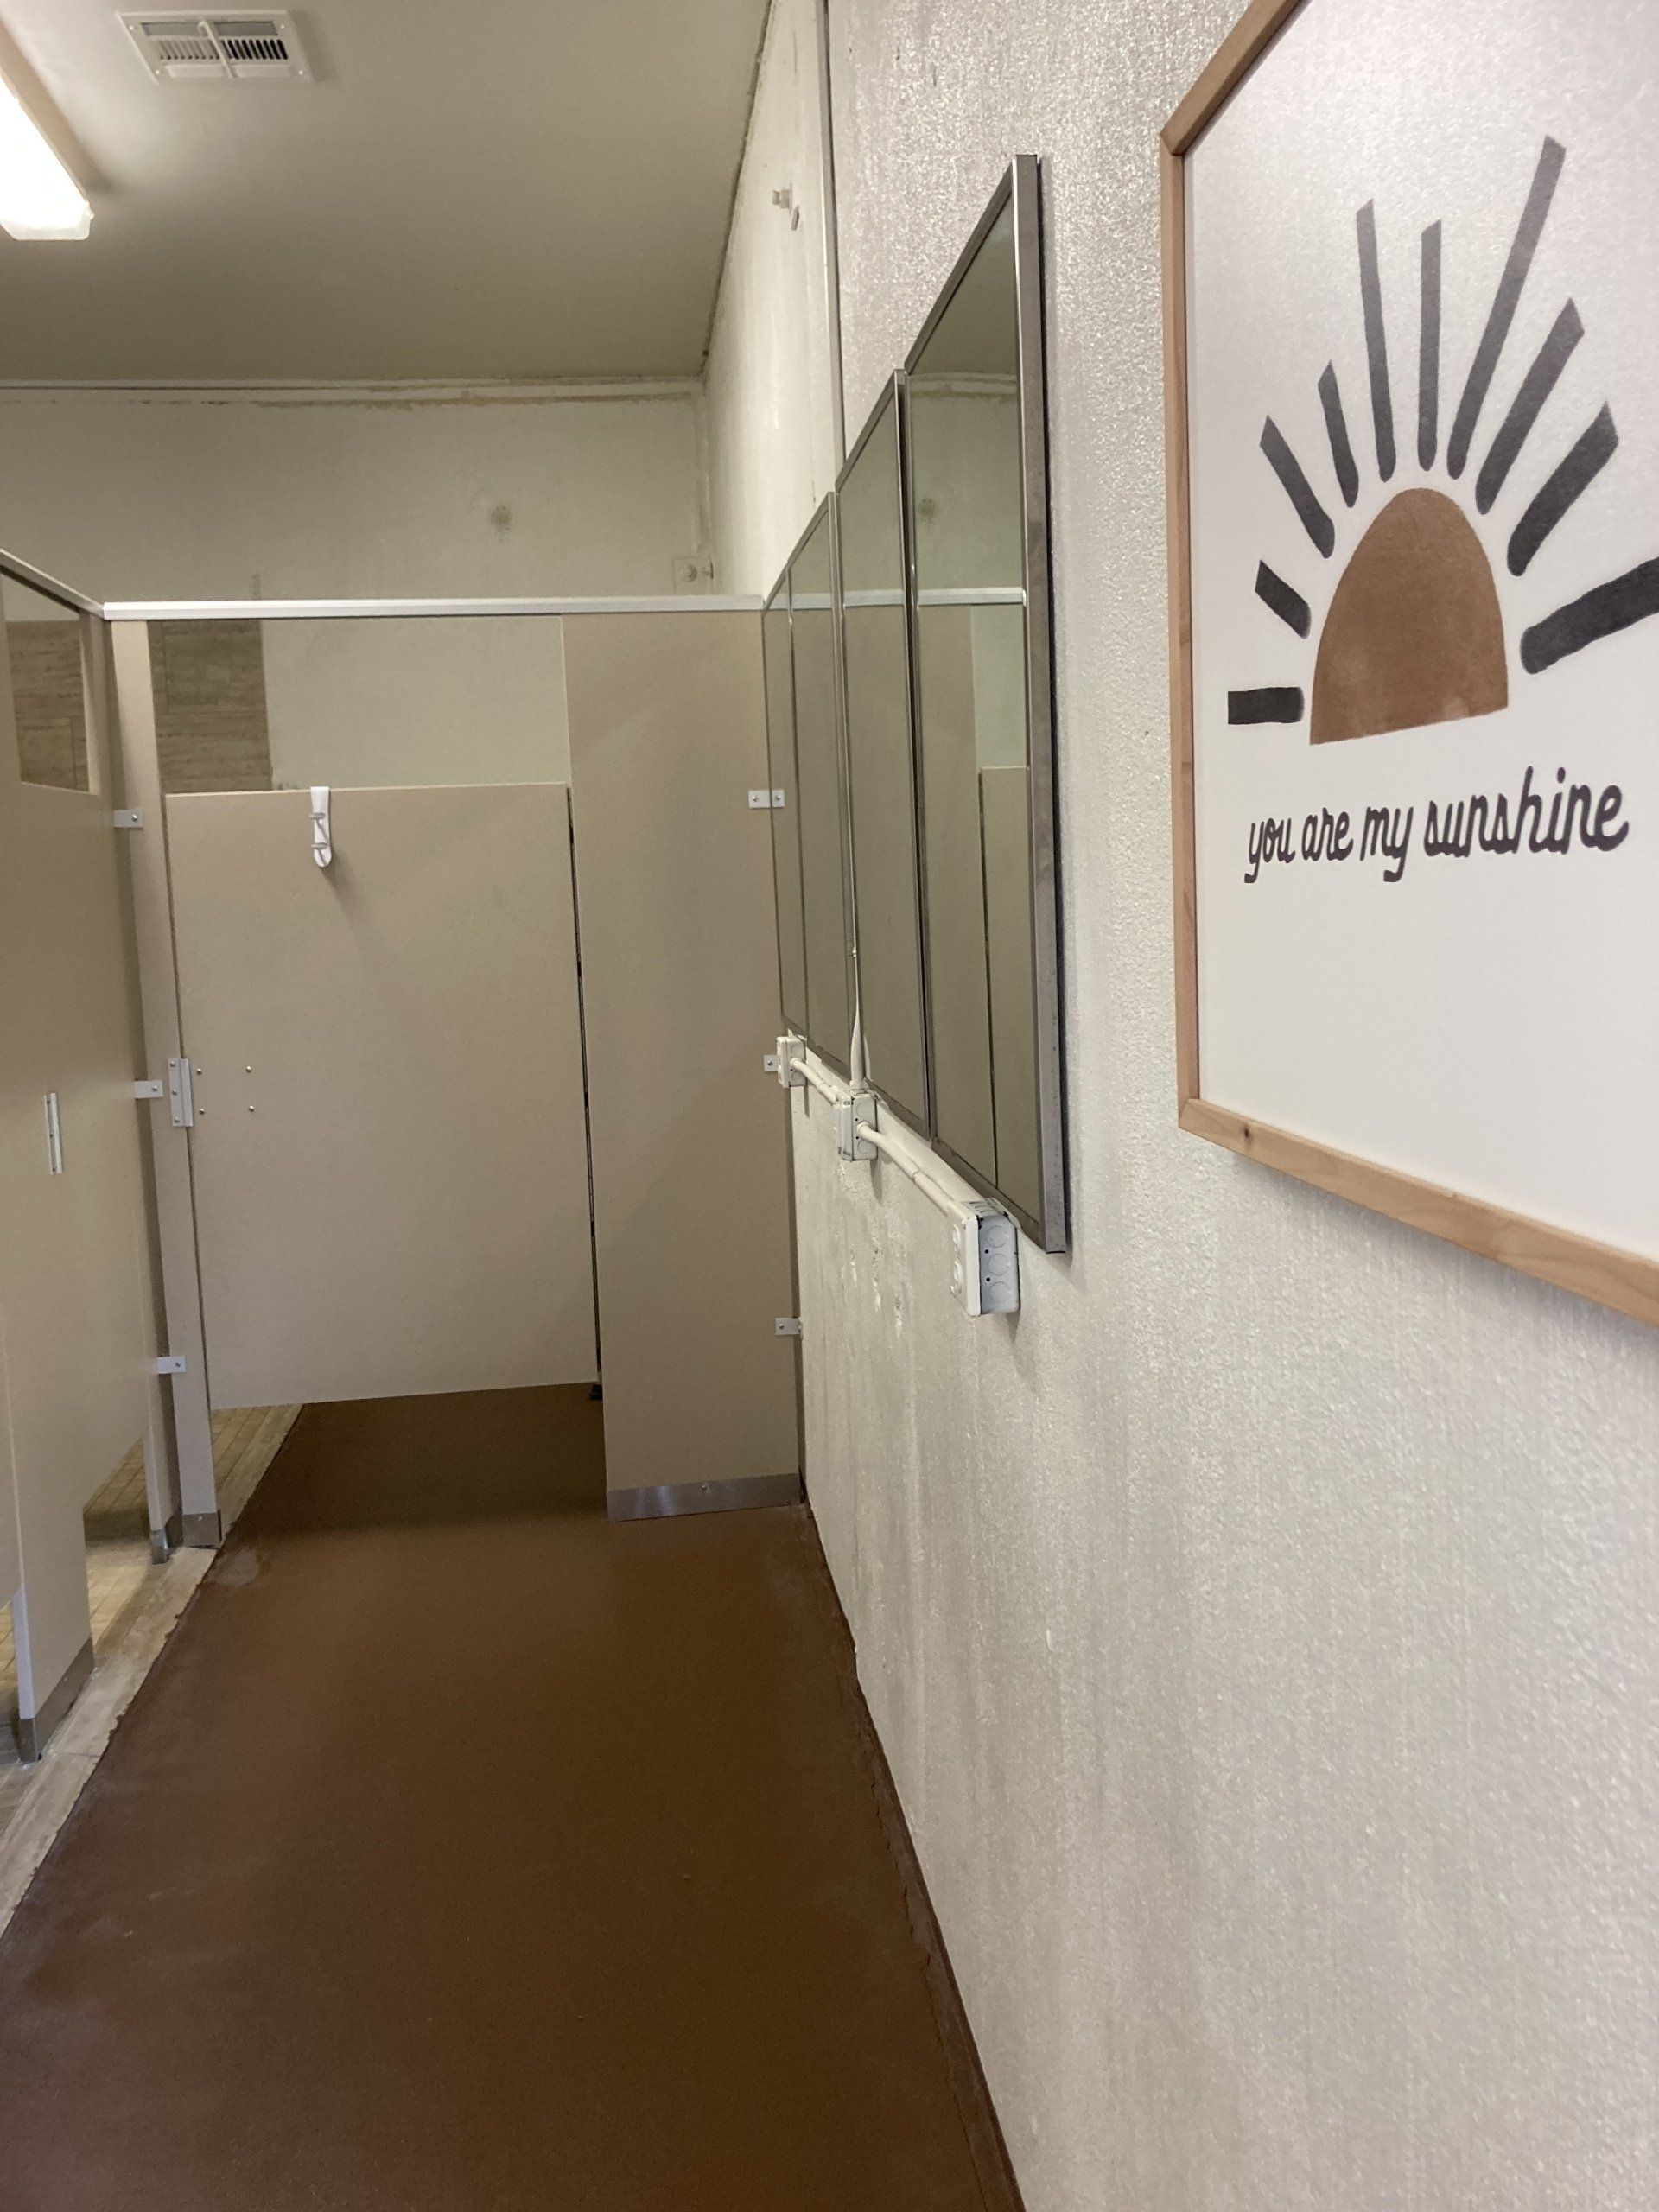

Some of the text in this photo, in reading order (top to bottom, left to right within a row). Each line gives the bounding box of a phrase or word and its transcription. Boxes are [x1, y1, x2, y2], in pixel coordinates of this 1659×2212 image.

[1244, 766, 1629, 884] you are my sunshine
